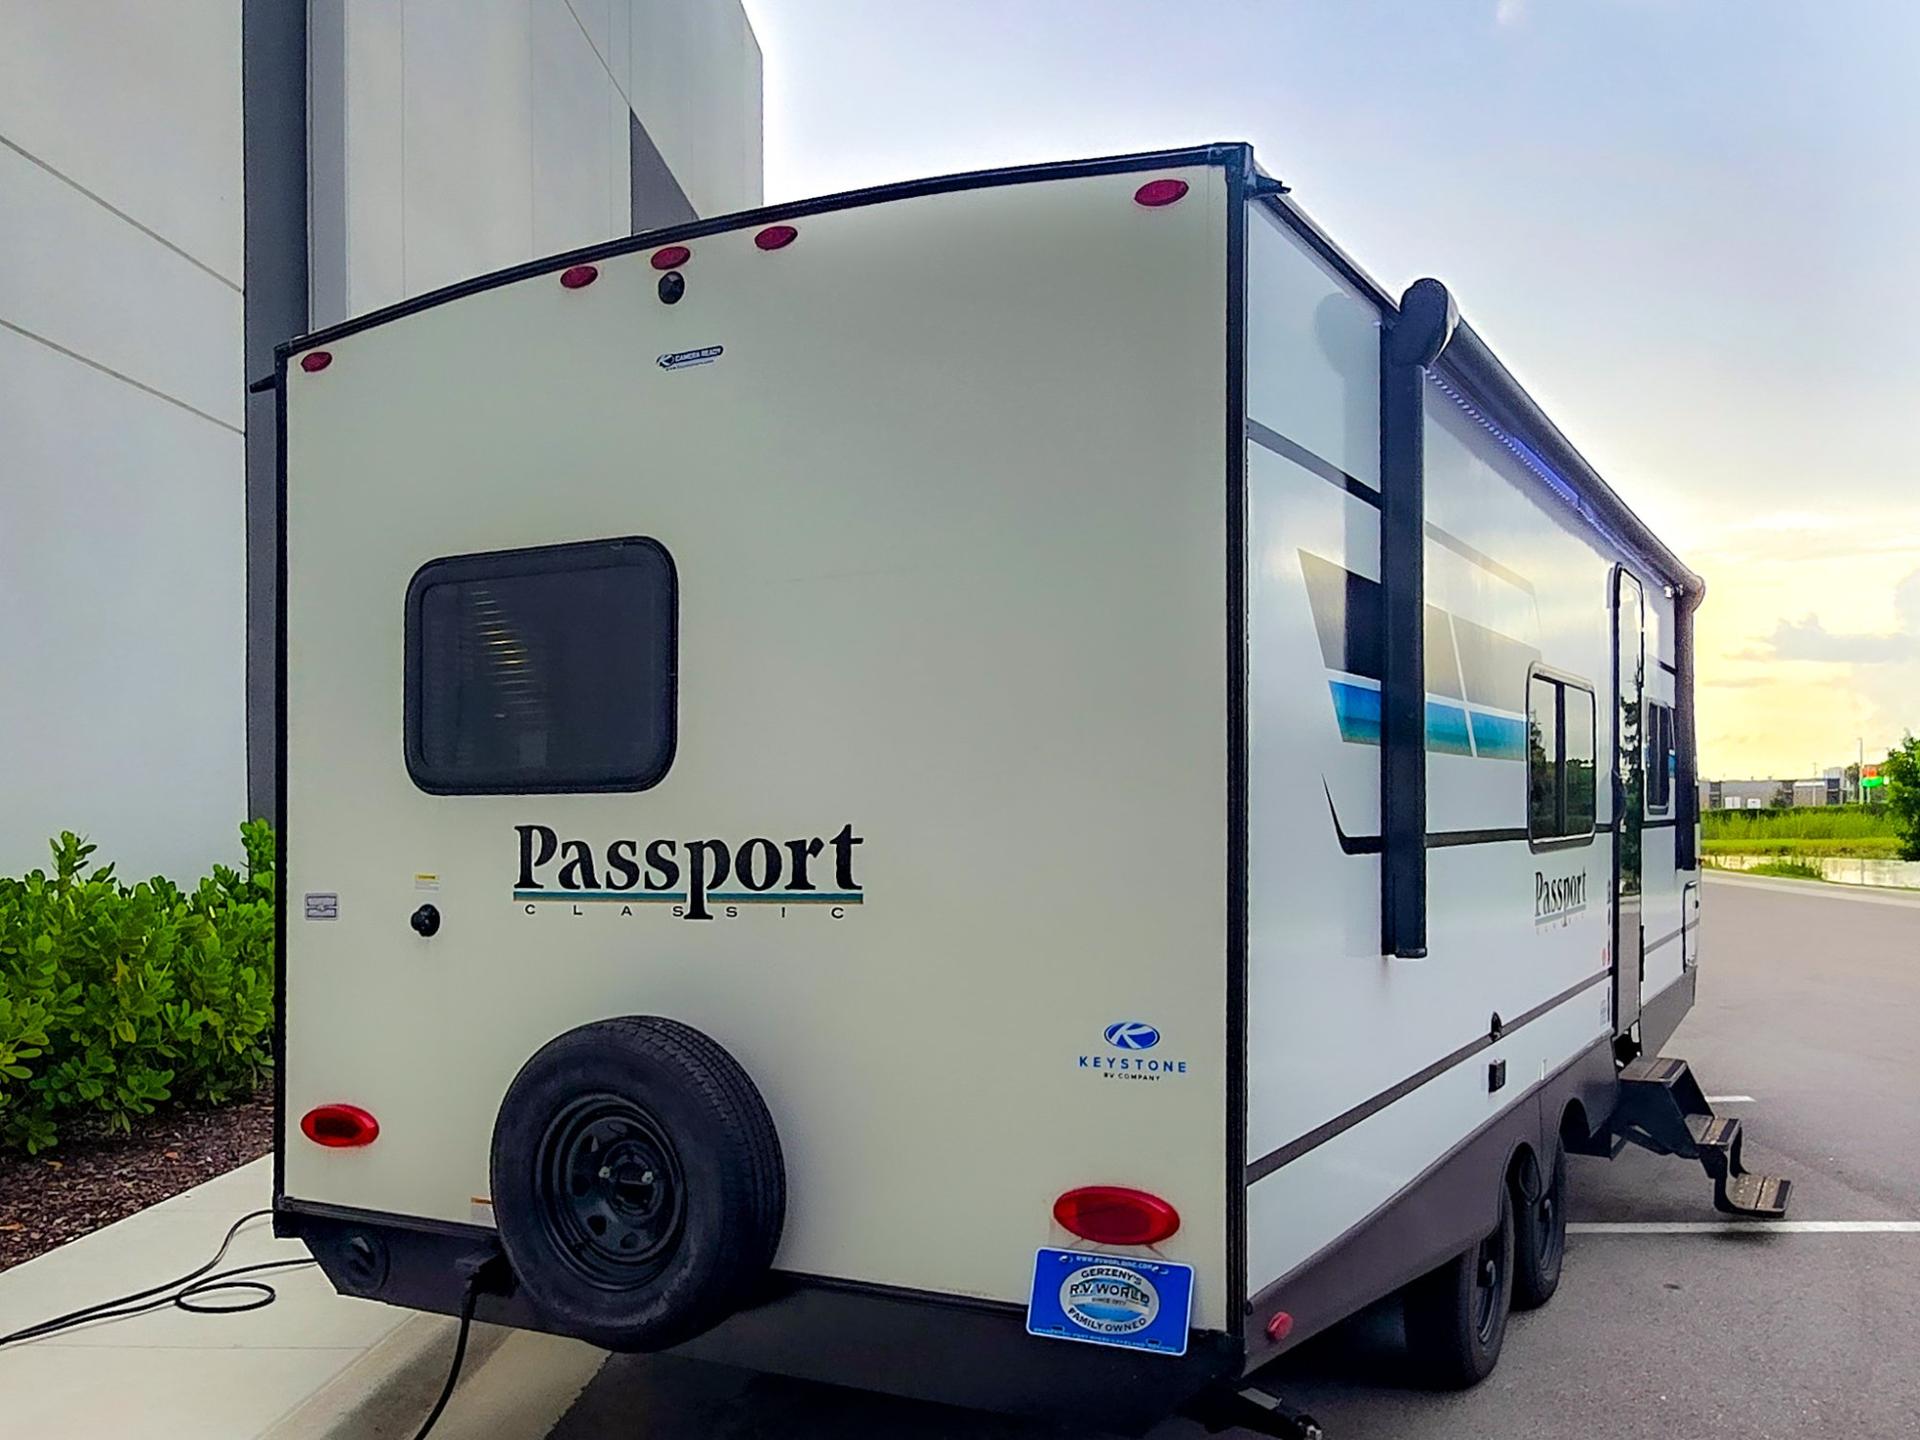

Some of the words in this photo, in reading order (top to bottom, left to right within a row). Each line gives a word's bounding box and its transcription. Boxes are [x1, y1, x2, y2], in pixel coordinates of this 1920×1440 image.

[514, 824, 863, 920] Passport
[1535, 866, 1586, 928] Passport
[524, 903, 845, 919] CLASSIC
[1079, 1056, 1187, 1073] KEYSTONE
[1118, 1072, 1160, 1081] COMPANY
[1081, 1268, 1142, 1286] GERZENY'S
[1096, 1284, 1150, 1304] WORLD
[1068, 1307, 1103, 1331] FAMILY
[1105, 1317, 1147, 1332] OWNED
